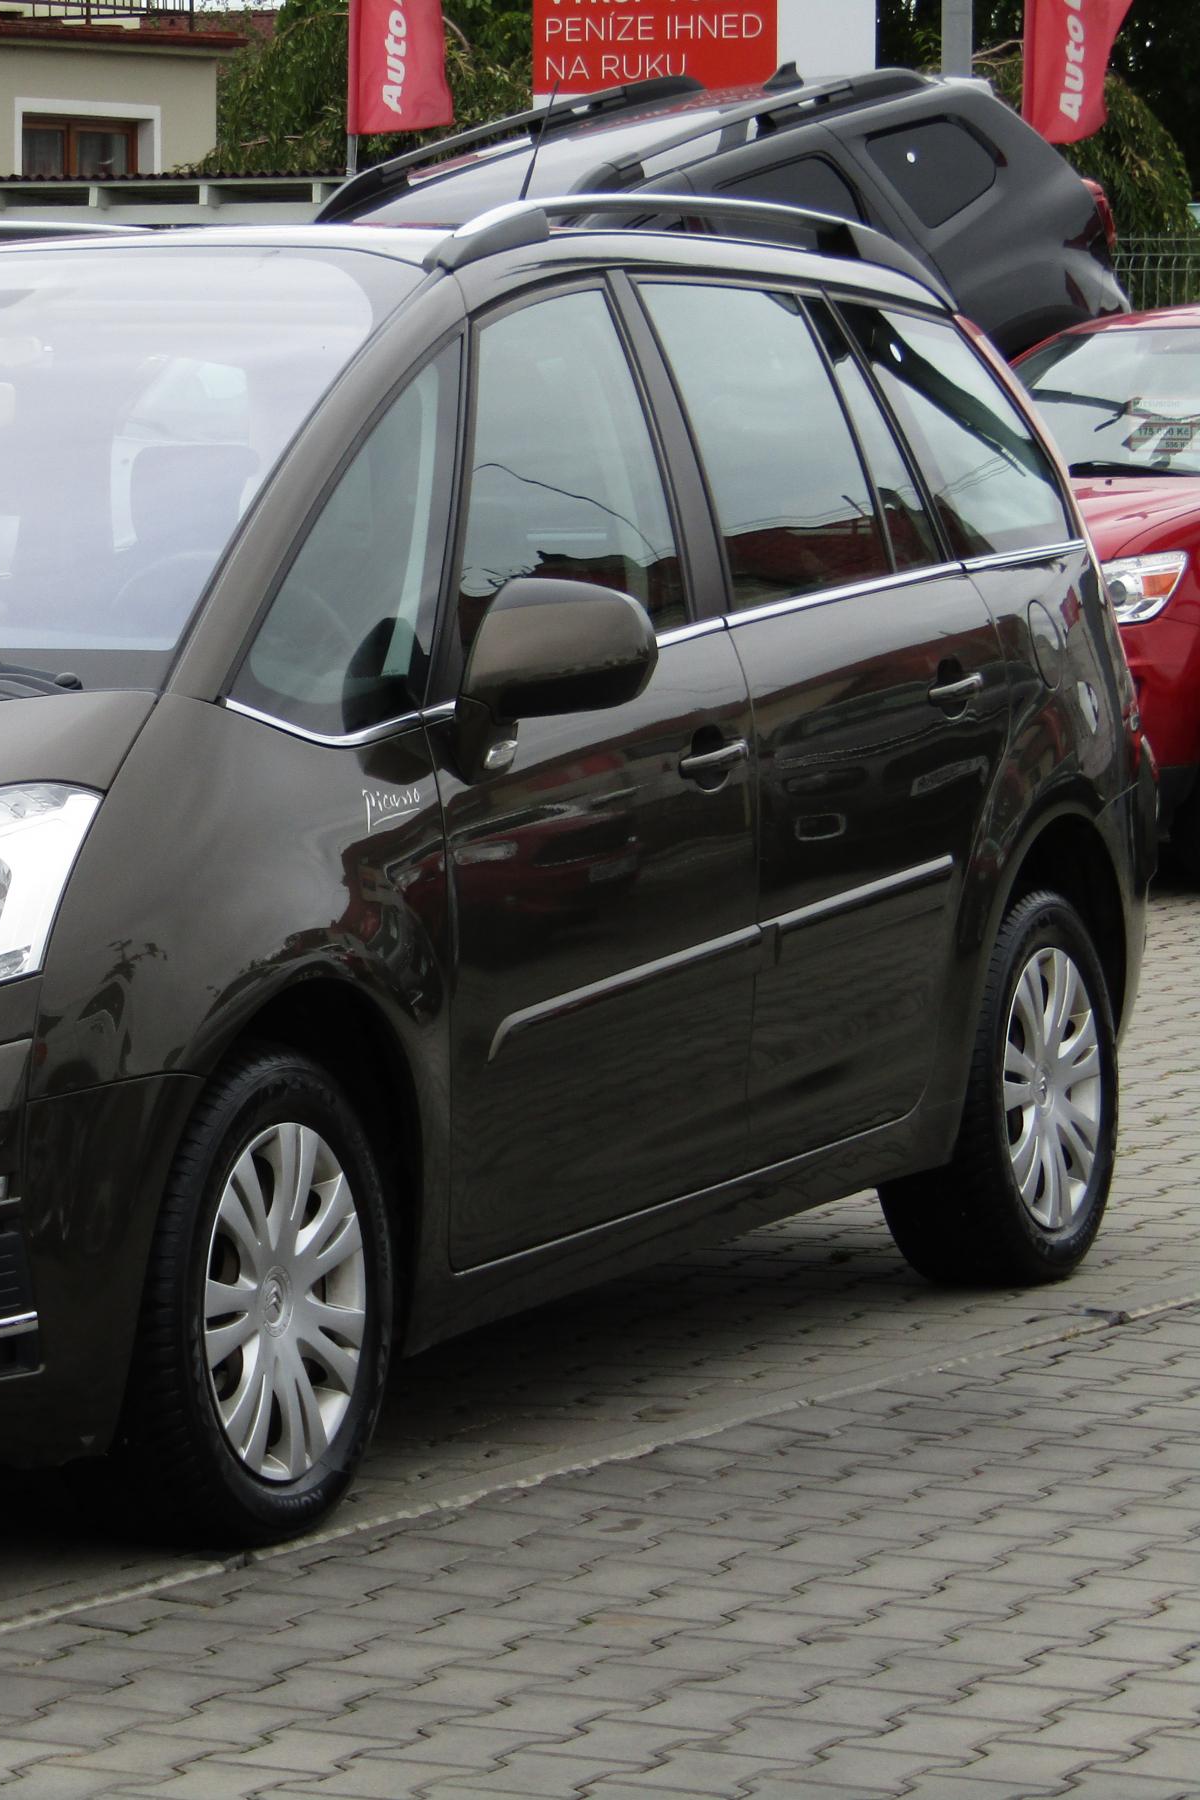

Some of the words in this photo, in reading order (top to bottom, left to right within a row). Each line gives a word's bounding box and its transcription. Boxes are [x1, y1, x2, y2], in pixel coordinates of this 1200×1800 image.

[545, 11, 655, 42] PENÍZE
[666, 13, 763, 40] IHNED
[382, 9, 407, 115] Auto
[545, 55, 590, 81] NA
[601, 52, 687, 80] RUKU
[1059, 14, 1085, 123] Auto
